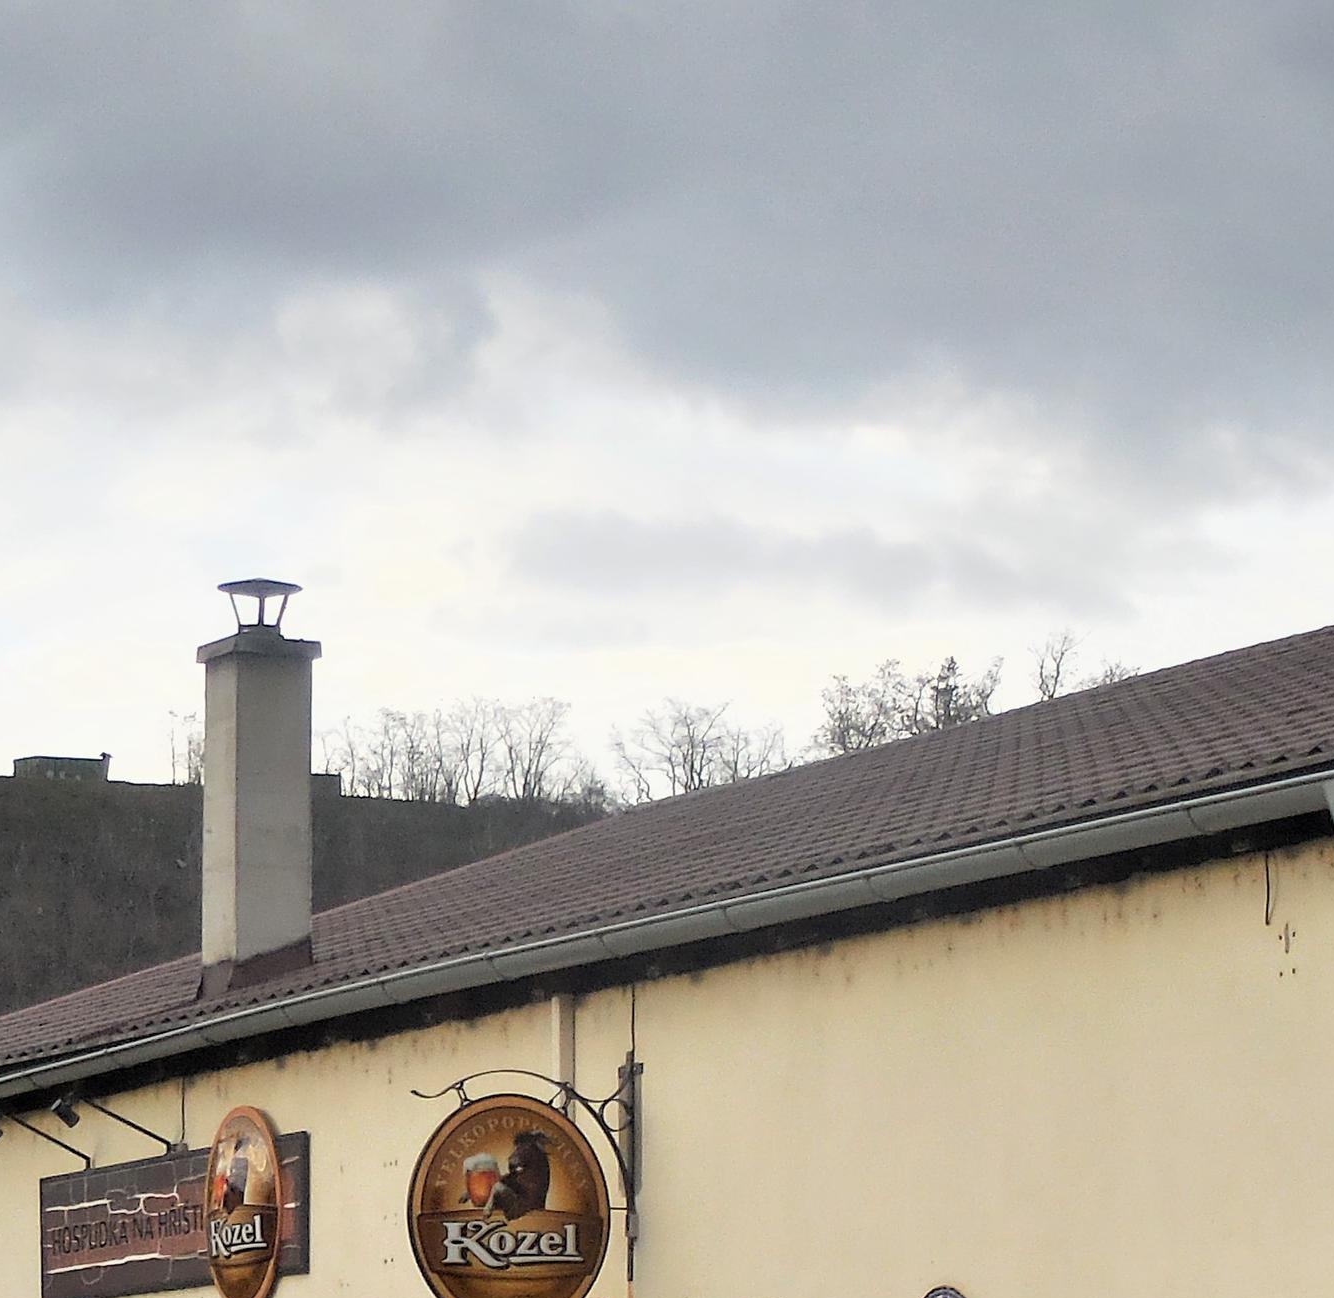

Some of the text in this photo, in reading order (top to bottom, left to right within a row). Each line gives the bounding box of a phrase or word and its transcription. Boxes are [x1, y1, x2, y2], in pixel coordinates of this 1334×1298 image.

[132, 1214, 154, 1240] NA
[210, 1214, 267, 1257] Kozel
[442, 1219, 584, 1268] Kozel
